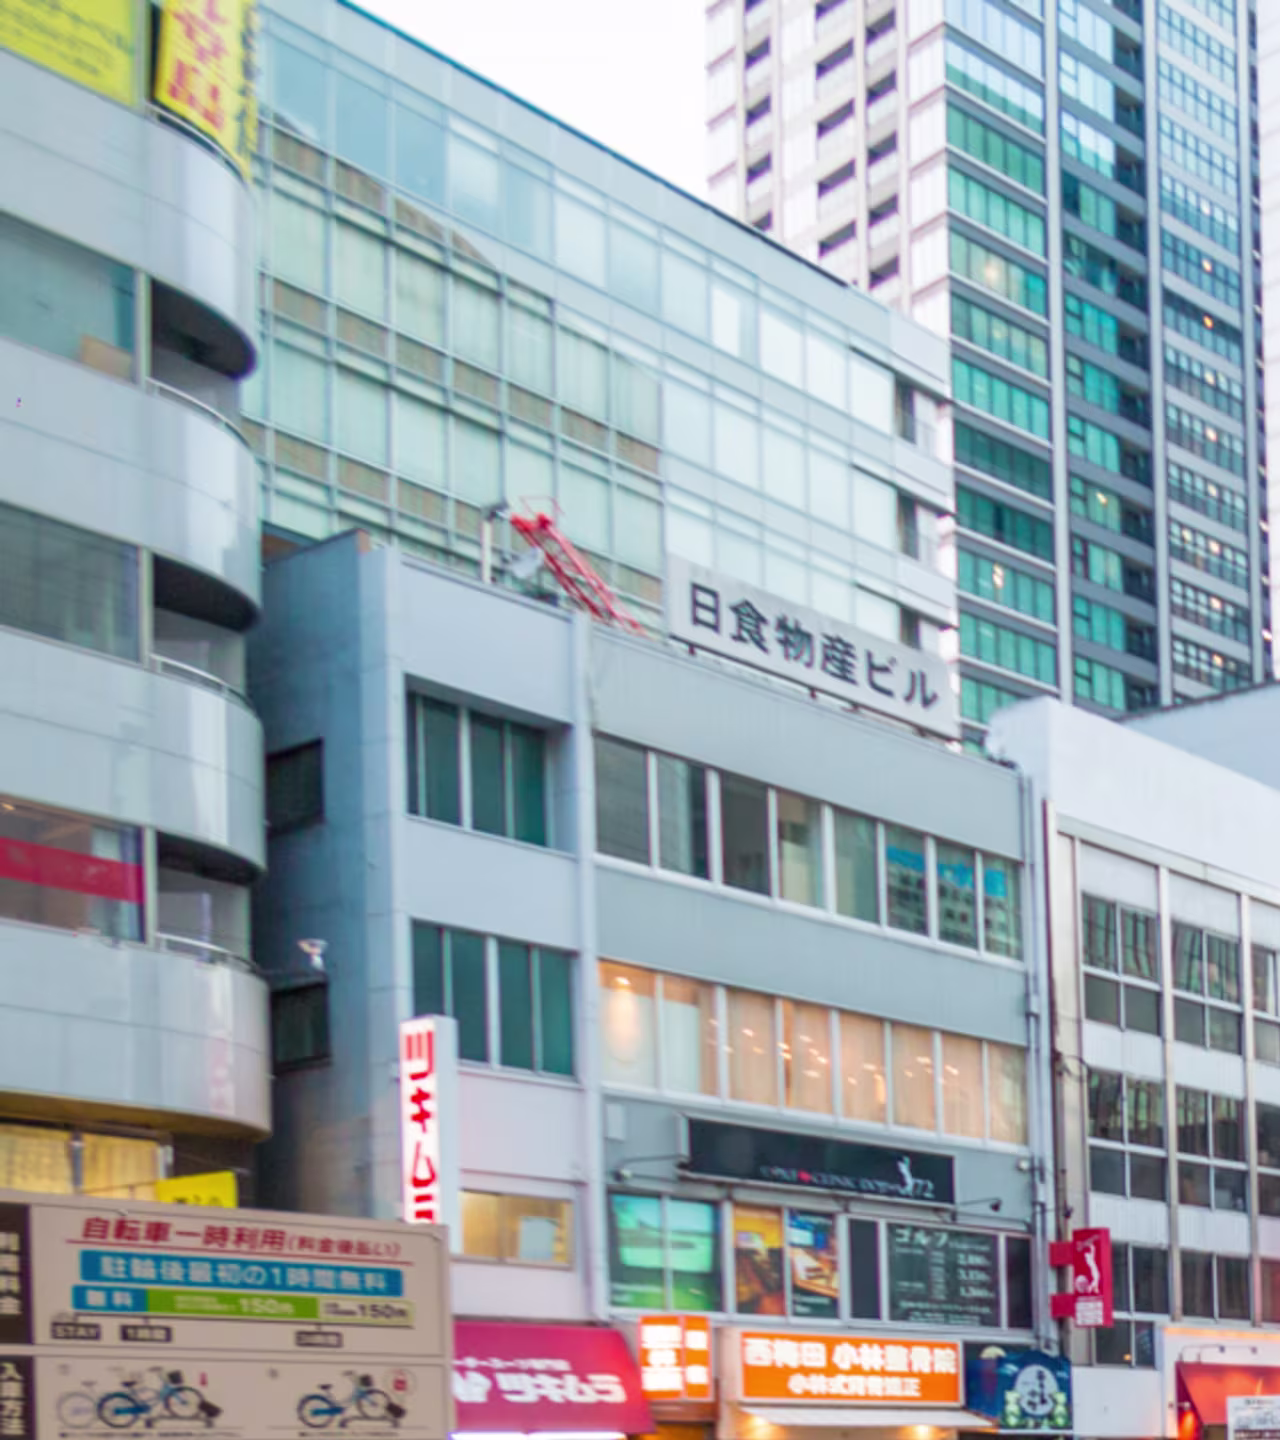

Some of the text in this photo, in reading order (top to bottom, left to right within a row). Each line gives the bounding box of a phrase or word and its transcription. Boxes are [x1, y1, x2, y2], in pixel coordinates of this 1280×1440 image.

[690, 581, 938, 709] 日食物産ビル
[100, 1254, 388, 1291] 駐輪後最初の1時間無料
[493, 1372, 627, 1403] ツキムラ
